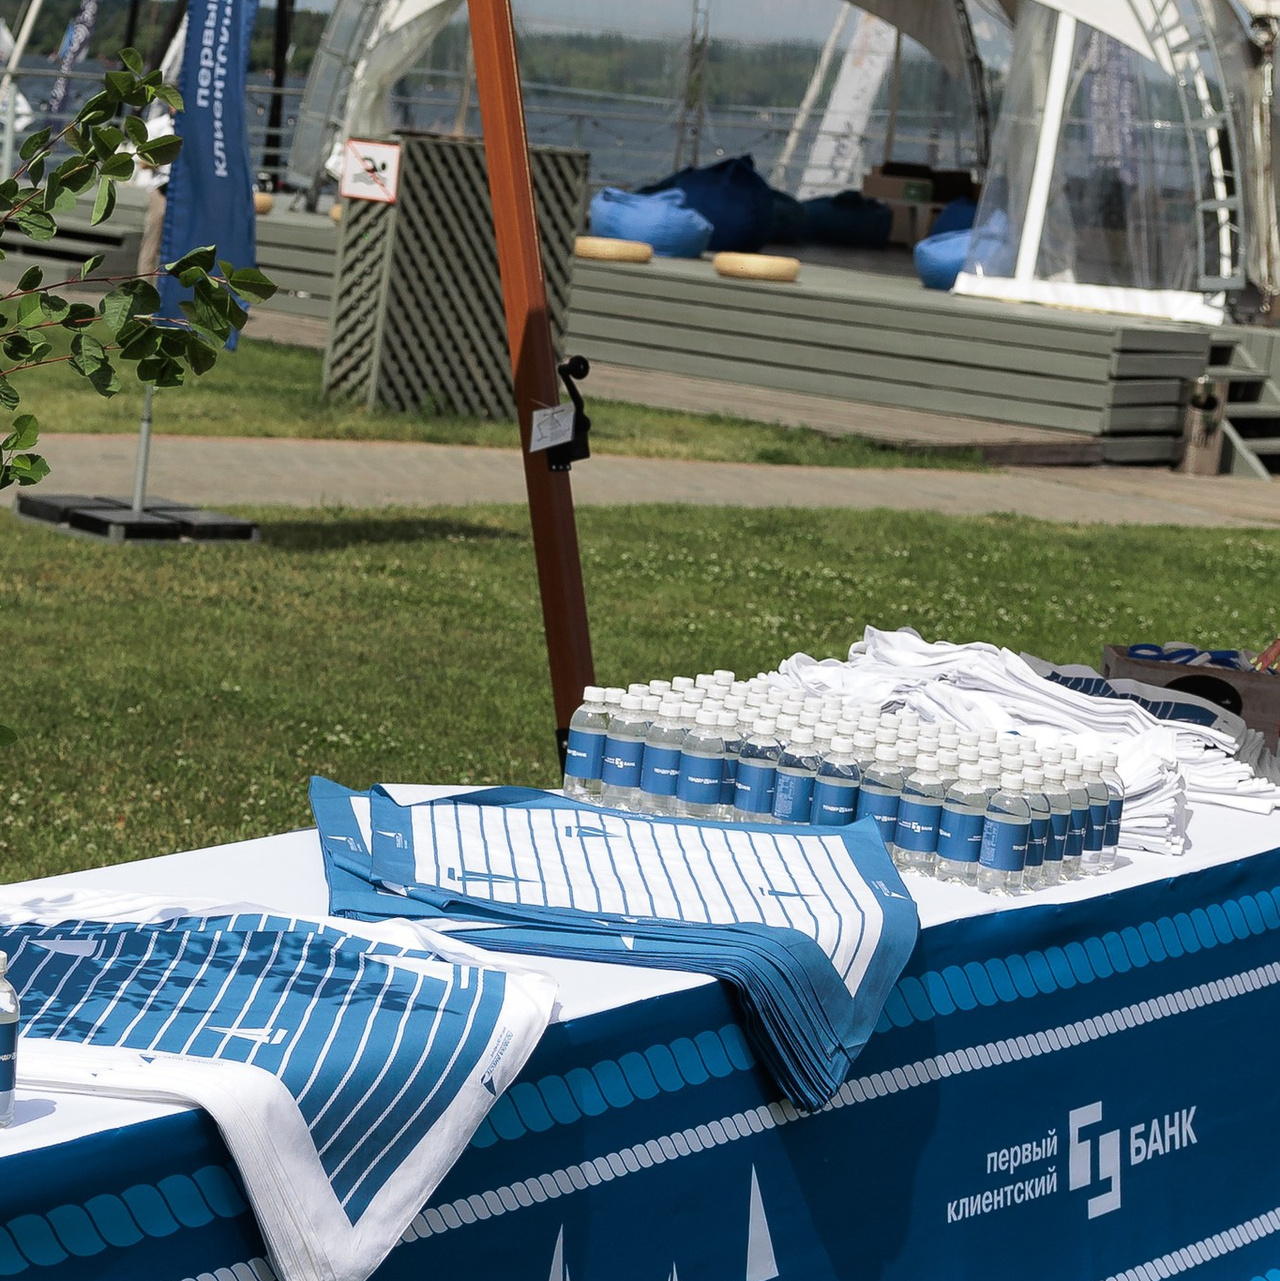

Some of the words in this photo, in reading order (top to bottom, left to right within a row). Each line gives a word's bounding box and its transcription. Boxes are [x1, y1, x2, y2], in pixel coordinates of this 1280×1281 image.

[986, 1128, 1058, 1174] первый
[1130, 1105, 1198, 1166] БАНК
[947, 1165, 1057, 1223] клиентский
